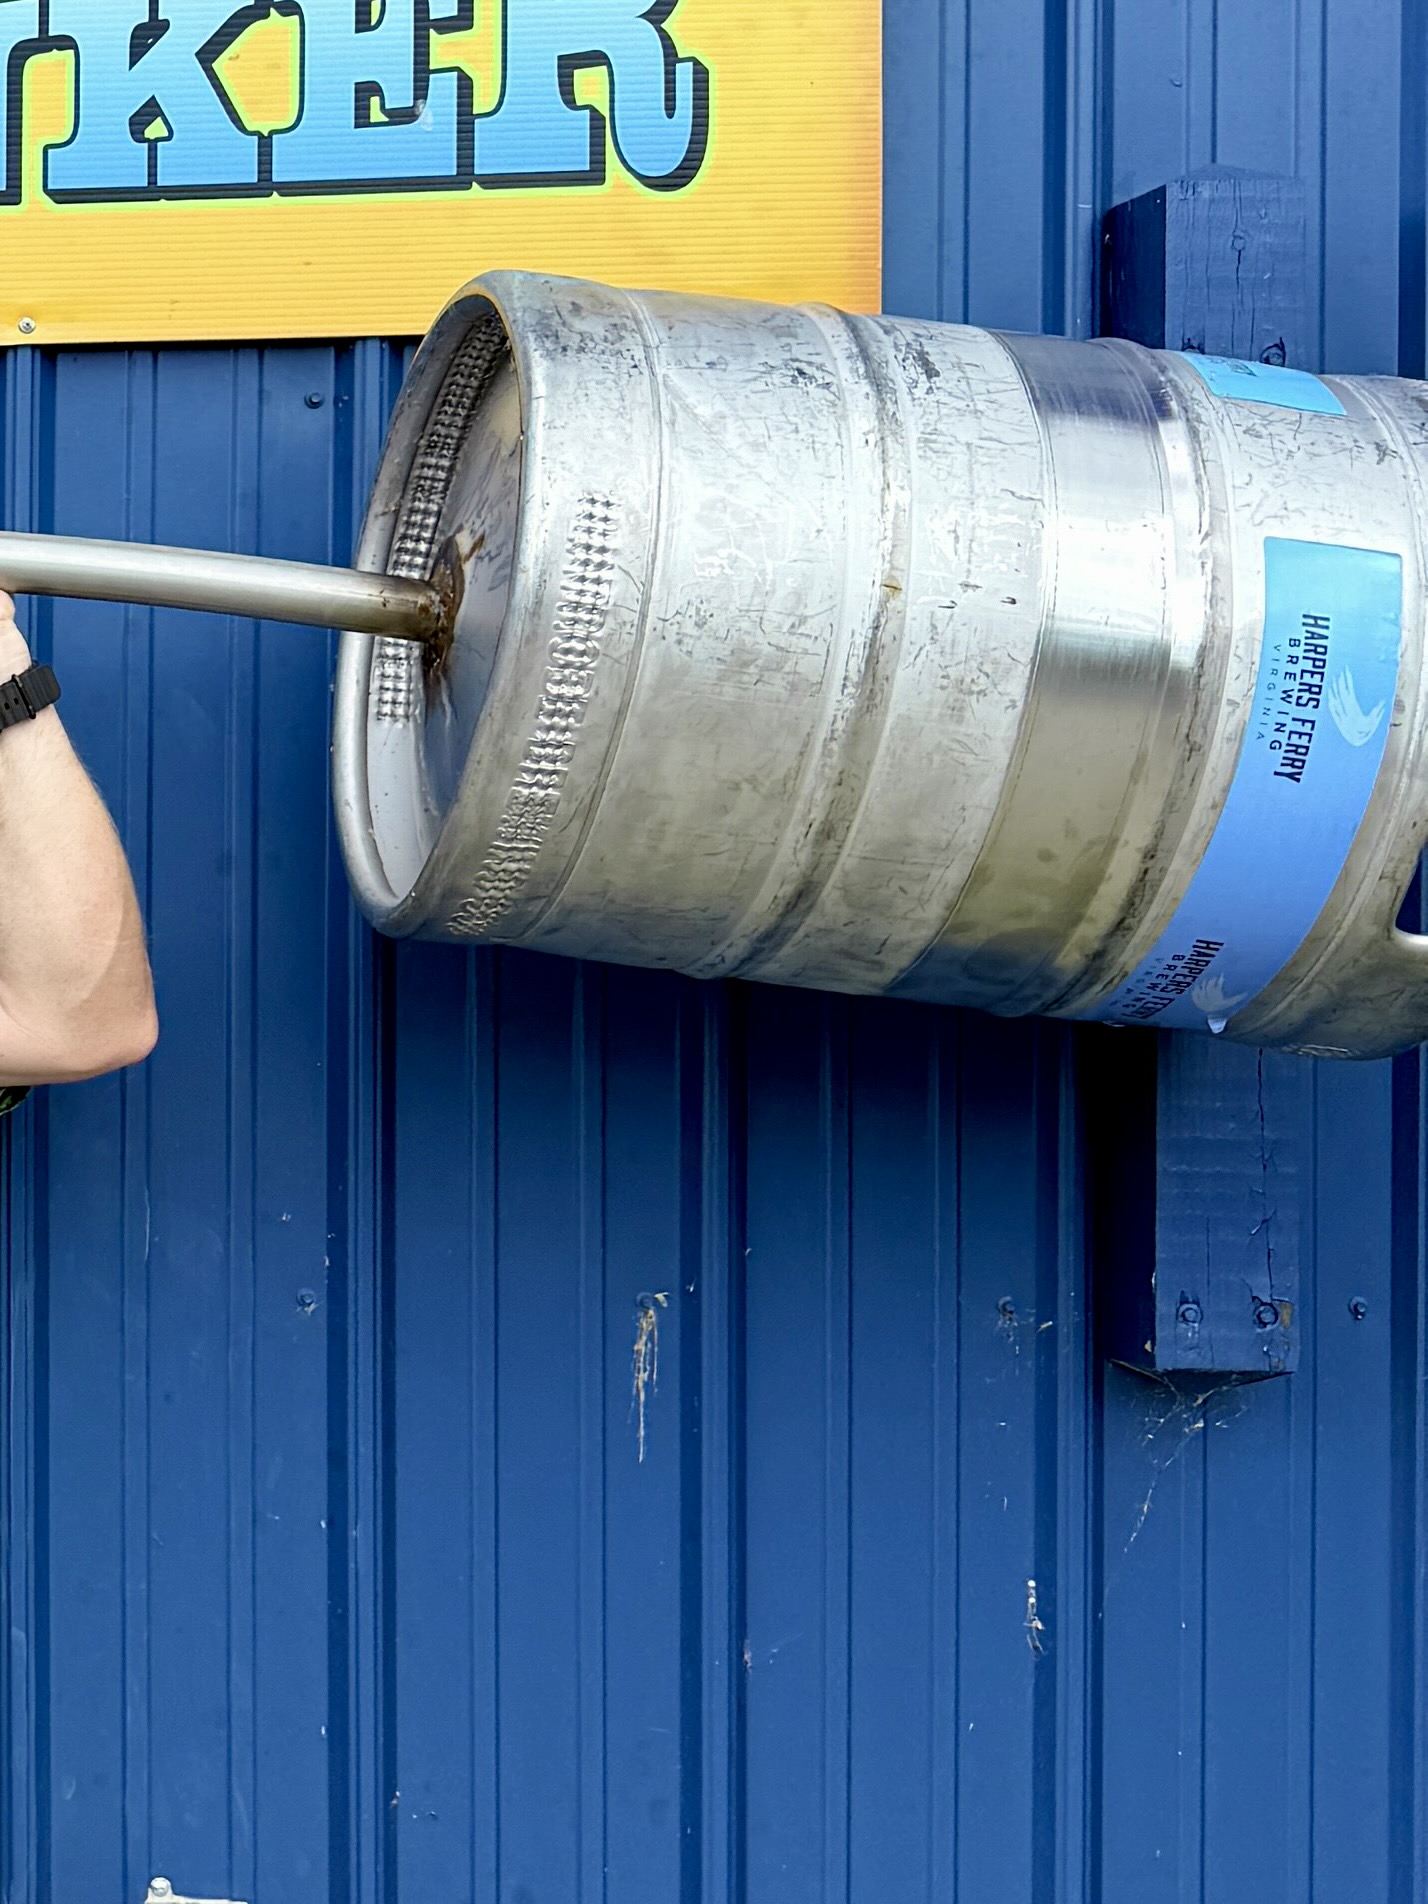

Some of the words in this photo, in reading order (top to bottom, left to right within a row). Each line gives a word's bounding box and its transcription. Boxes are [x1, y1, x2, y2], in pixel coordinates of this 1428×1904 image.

[1256, 643, 1282, 741] VIRGINIA
[1269, 637, 1301, 752] BREWING
[1294, 613, 1331, 710] HARPERS
[1272, 716, 1317, 784] FERRY
[1159, 938, 1225, 995] HARPERS
